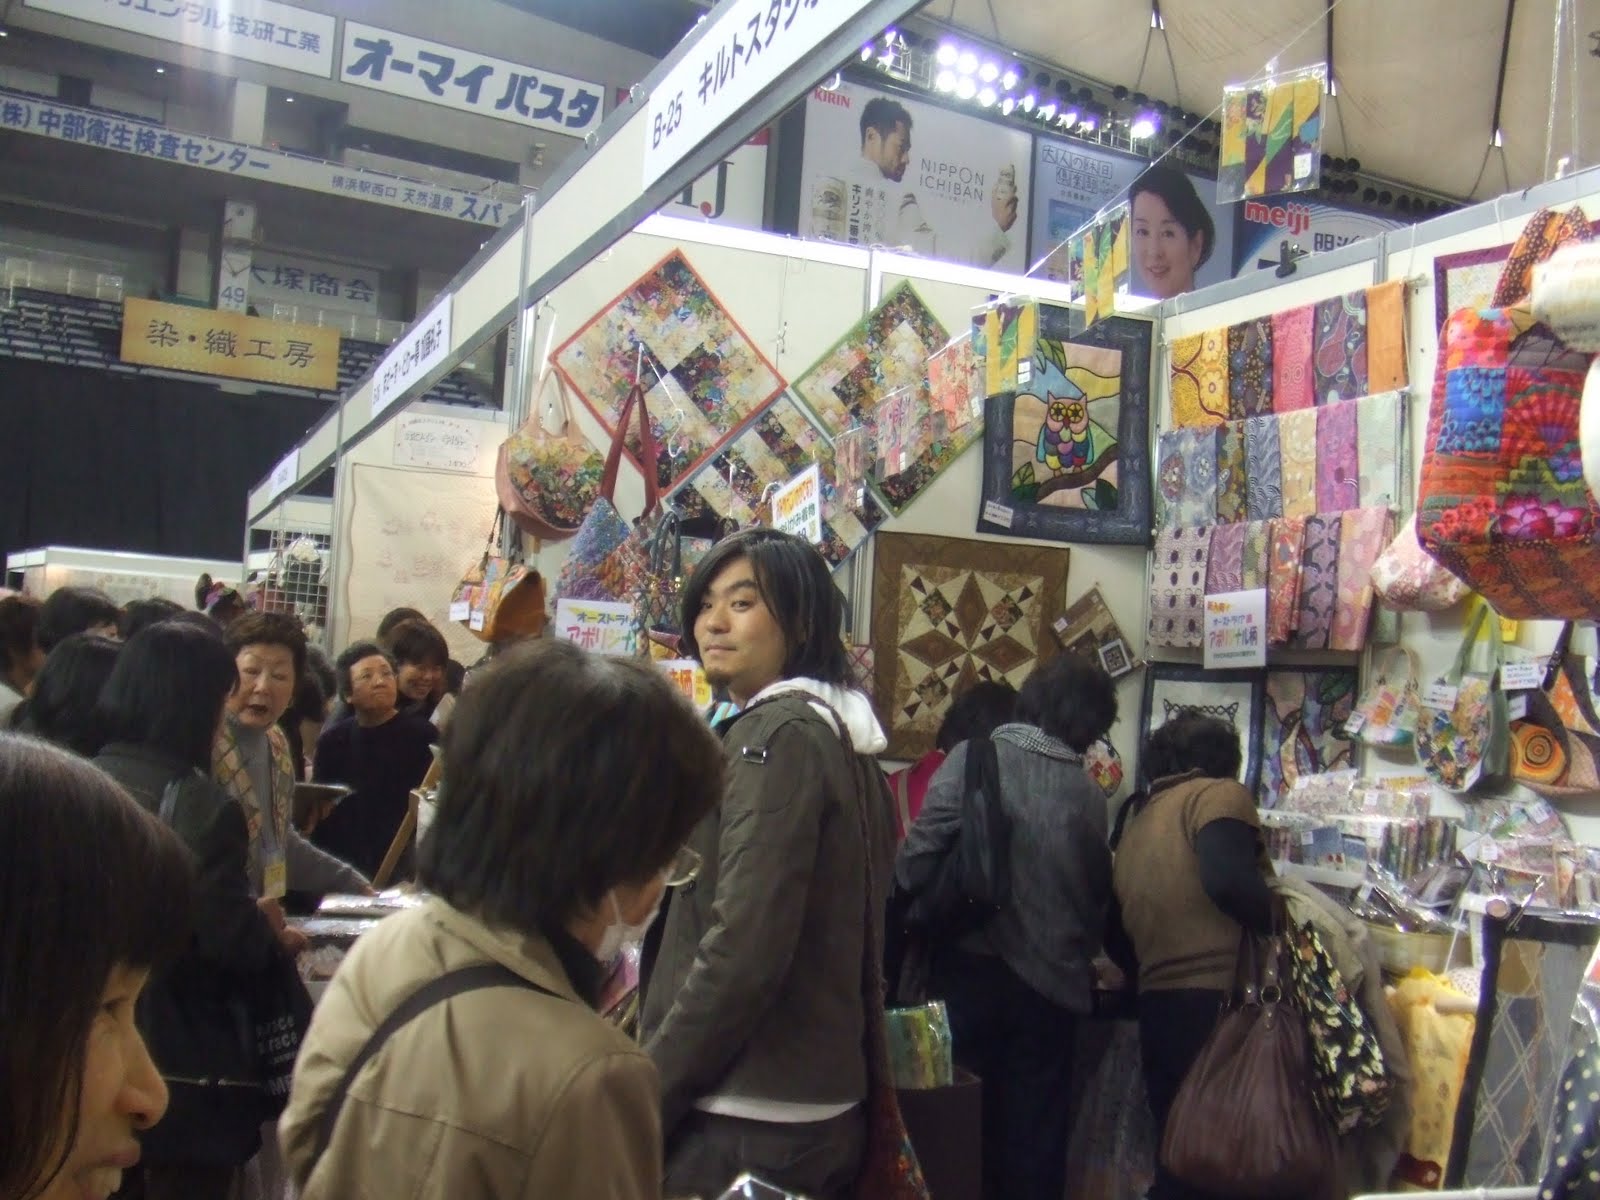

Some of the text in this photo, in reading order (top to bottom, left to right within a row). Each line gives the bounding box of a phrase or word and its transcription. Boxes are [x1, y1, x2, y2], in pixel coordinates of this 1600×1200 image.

[652, 0, 819, 151] B-25 キルトスタジ
[814, 88, 851, 107] KIRIN
[921, 158, 985, 186] NIPPON
[920, 174, 983, 202] ICHIBAN
[1244, 201, 1310, 236] meiji
[221, 285, 246, 304] 49
